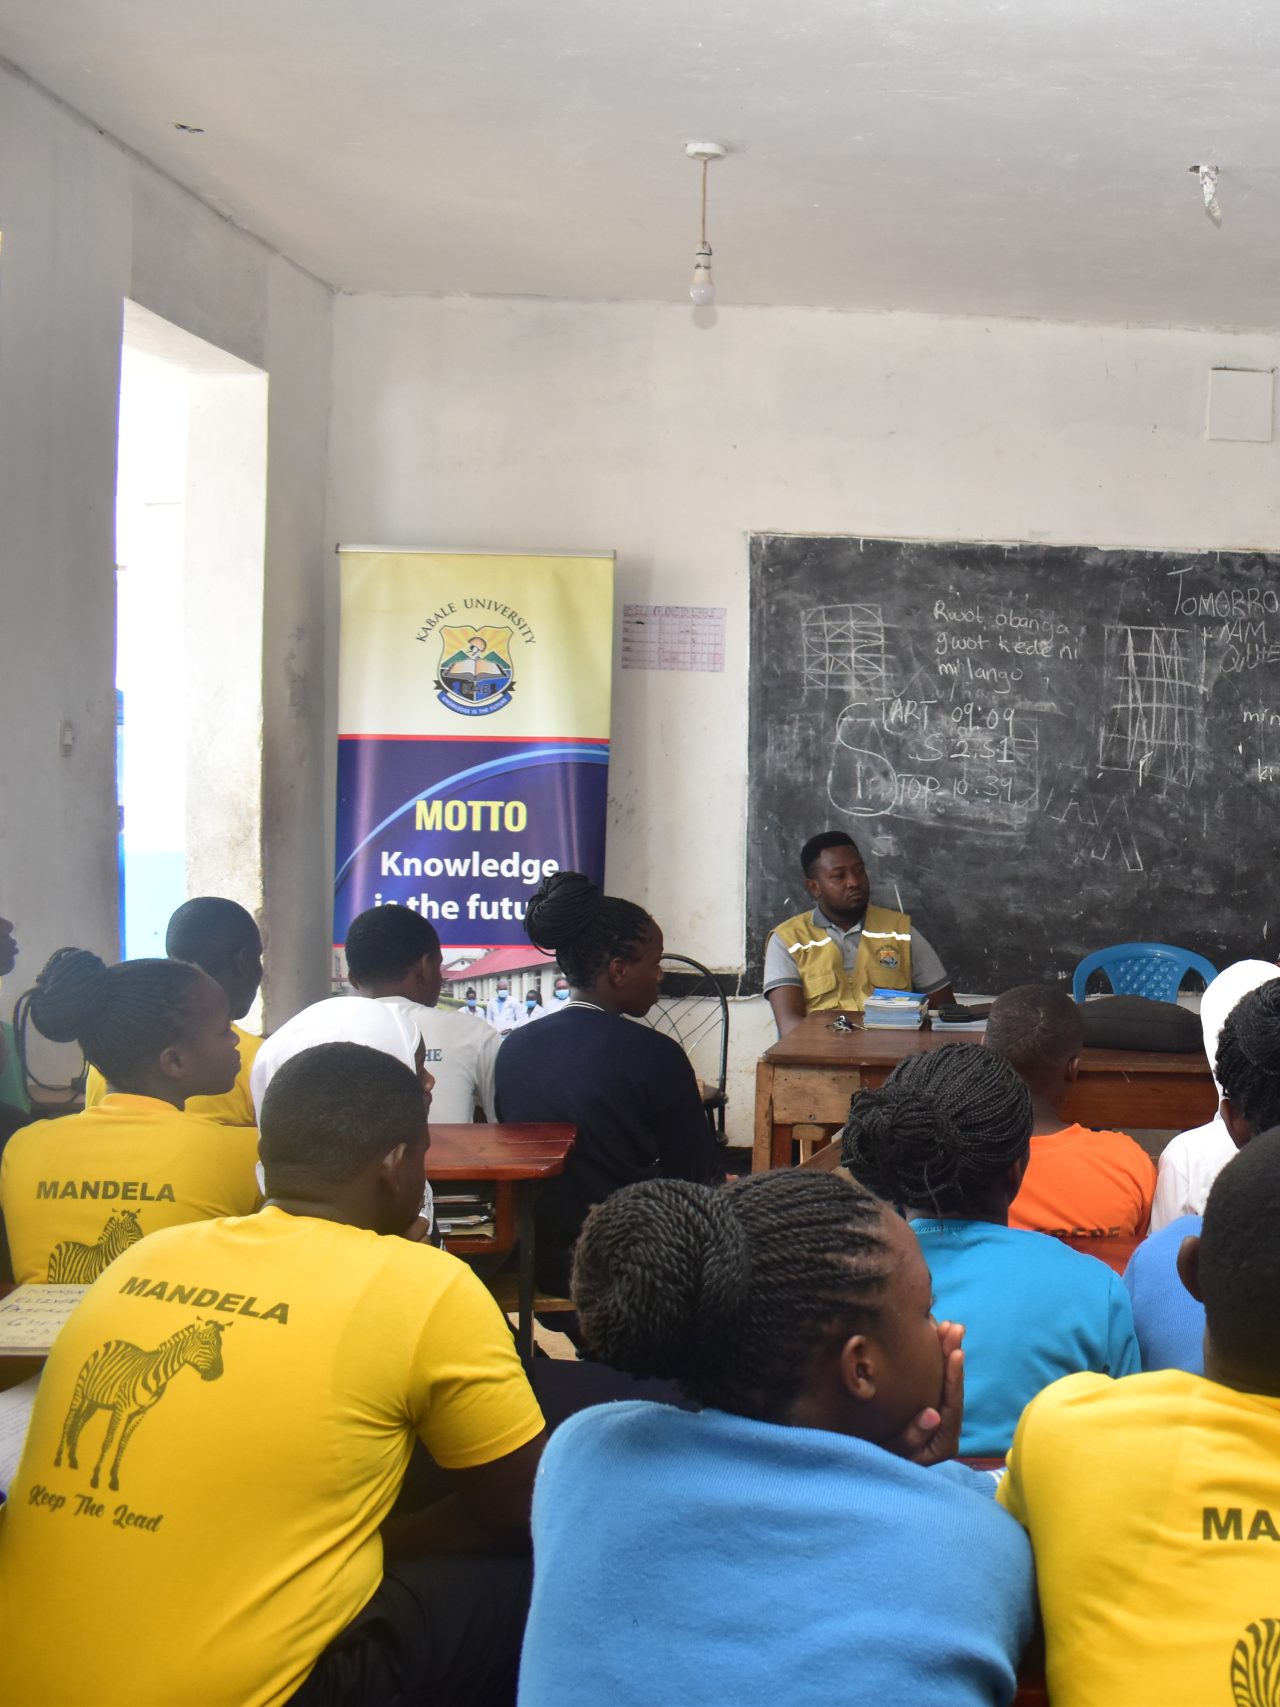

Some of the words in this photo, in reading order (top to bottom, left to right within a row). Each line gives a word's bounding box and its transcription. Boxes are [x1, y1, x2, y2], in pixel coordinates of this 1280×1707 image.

[416, 603, 457, 643] KABALE
[463, 598, 536, 645] UNIVERSITY
[415, 800, 527, 832] MOTTO
[381, 851, 559, 885] Knowledge
[406, 893, 460, 919] the
[466, 893, 528, 920] futu
[36, 1180, 176, 1203] MANDELA
[119, 1276, 290, 1325] MANDELA
[28, 1484, 66, 1512] Keep
[73, 1494, 105, 1517] The
[112, 1504, 164, 1532] Lead
